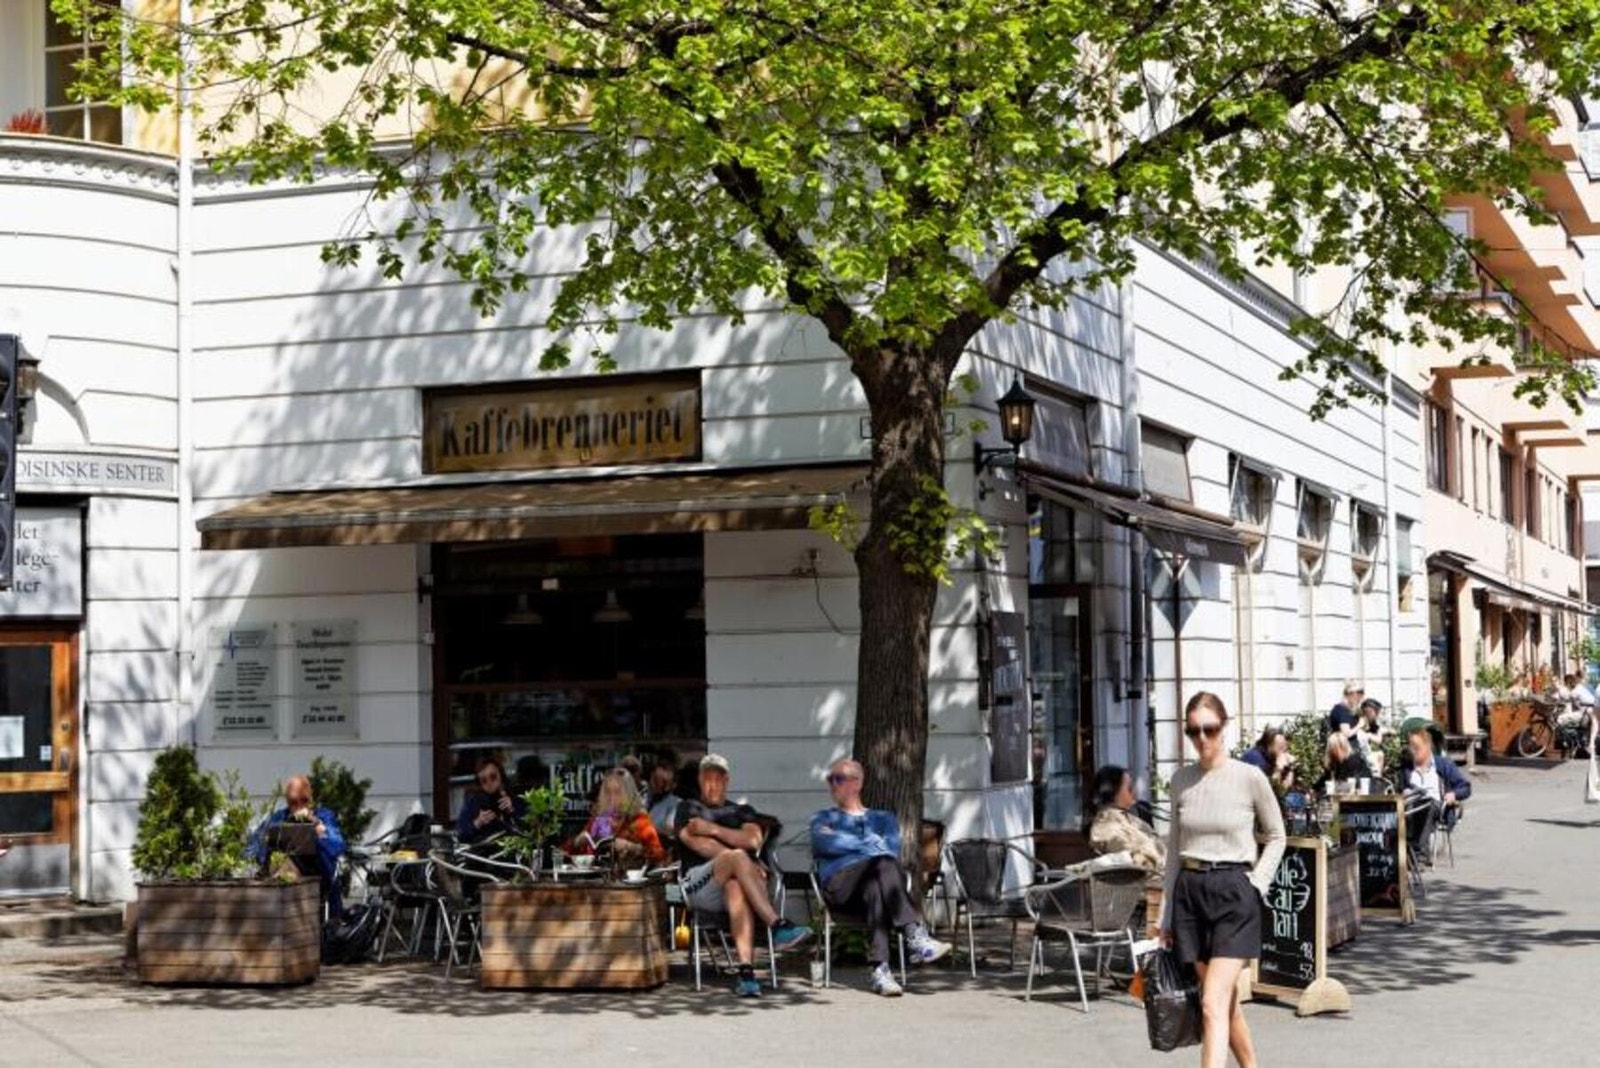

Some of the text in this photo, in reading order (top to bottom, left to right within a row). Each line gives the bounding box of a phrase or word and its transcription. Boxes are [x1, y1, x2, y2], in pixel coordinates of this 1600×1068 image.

[441, 396, 684, 457] Kaffebrenneriet
[106, 463, 165, 483] SENTER
[1274, 888, 1293, 913] au
